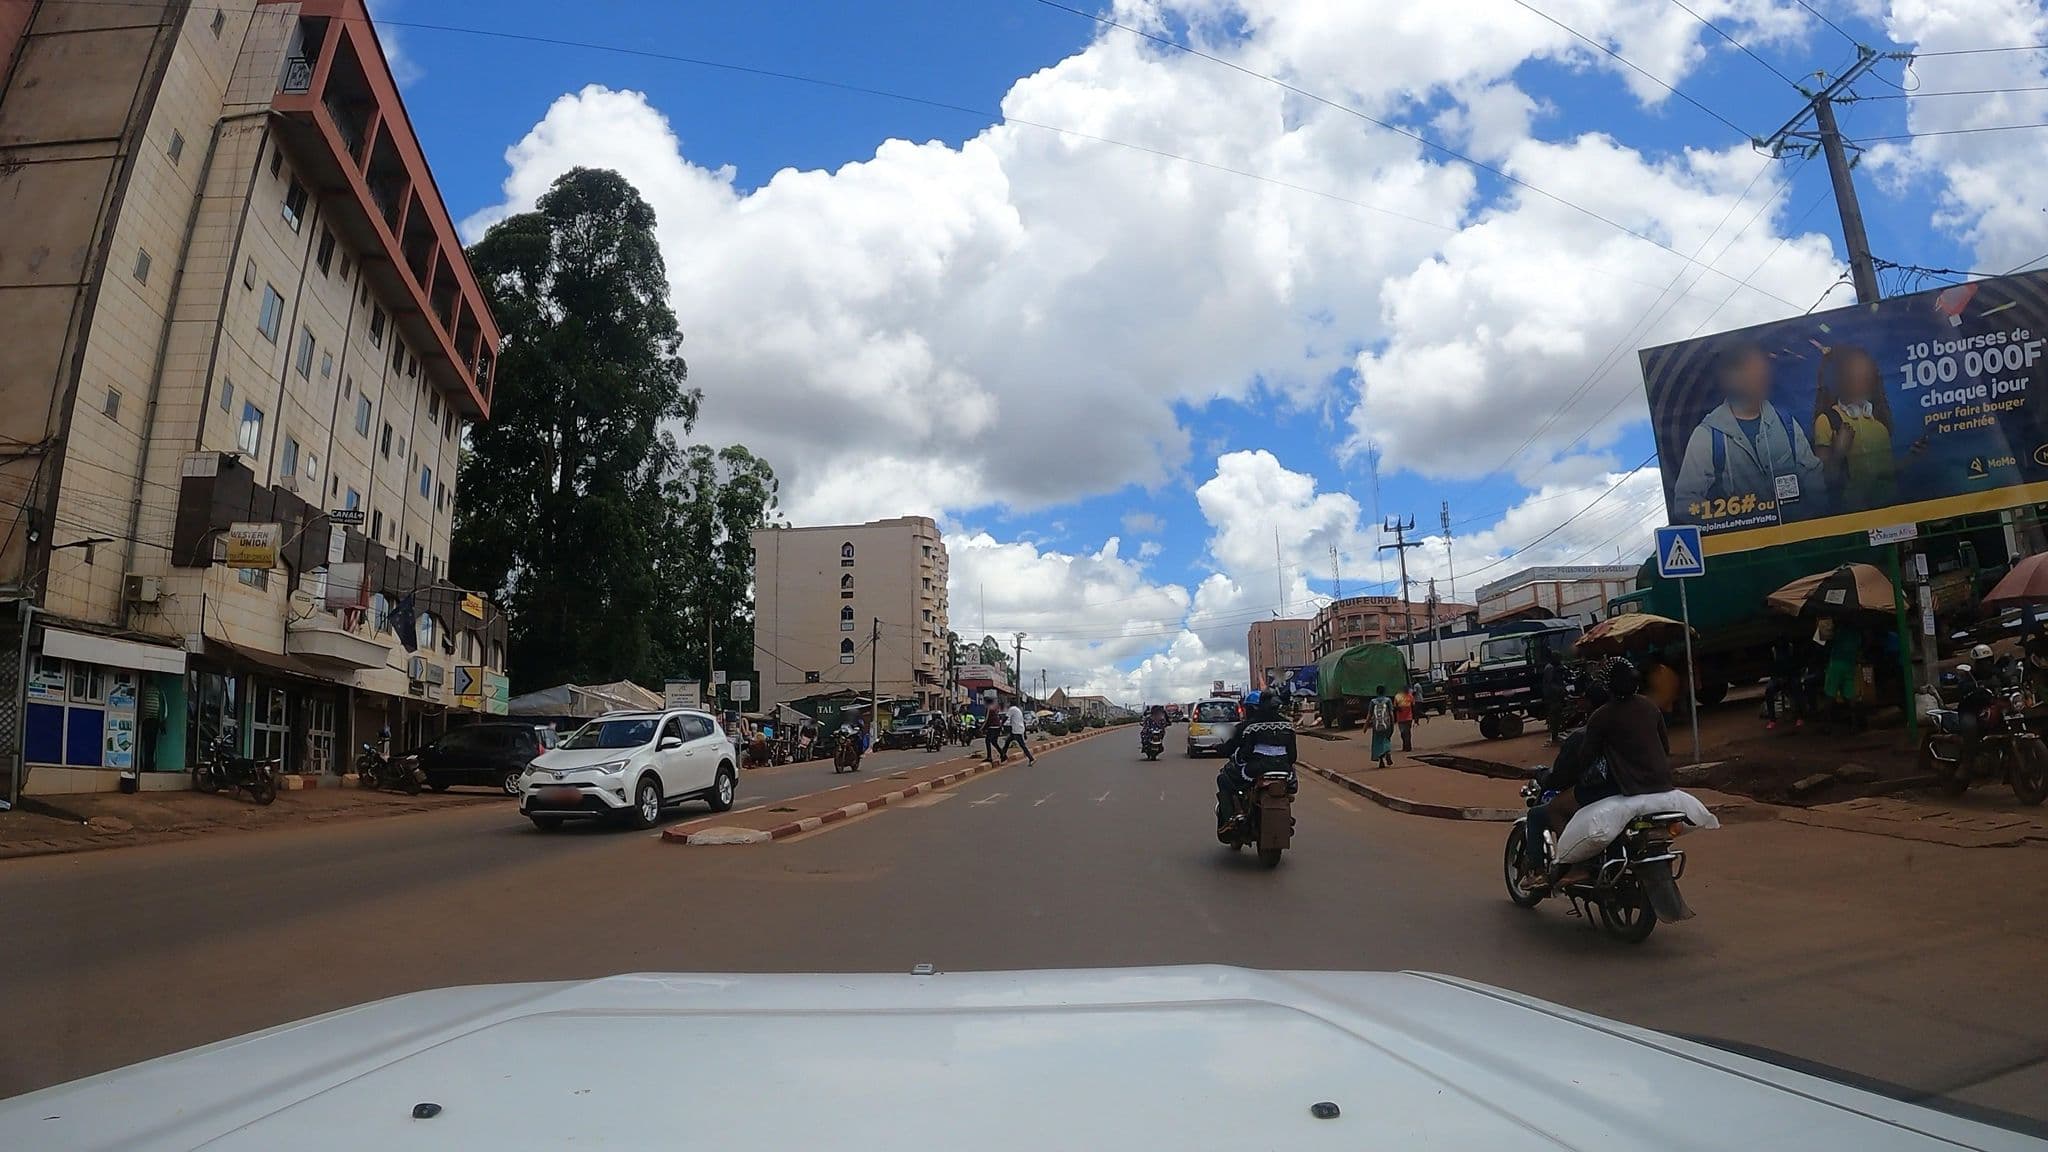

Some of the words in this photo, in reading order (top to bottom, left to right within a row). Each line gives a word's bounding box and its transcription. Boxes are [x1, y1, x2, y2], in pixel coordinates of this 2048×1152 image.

[1906, 342, 1929, 360] 10
[1933, 332, 2007, 356] bourses
[2011, 327, 2030, 341] de
[1900, 356, 1958, 390] 100
[1920, 384, 1987, 407] chaque
[1992, 377, 2029, 399] jour
[1924, 411, 1953, 426] pour
[1955, 405, 1980, 418] faire
[1982, 398, 2025, 411] bouger
[1939, 423, 1952, 434] ta
[1953, 414, 1996, 432] rentrée
[1988, 456, 2017, 469] MoMo
[1757, 500, 1776, 511] ou
[331, 510, 364, 519] CANAL+
[230, 530, 269, 539] WESTERN
[240, 538, 267, 547] UNION
